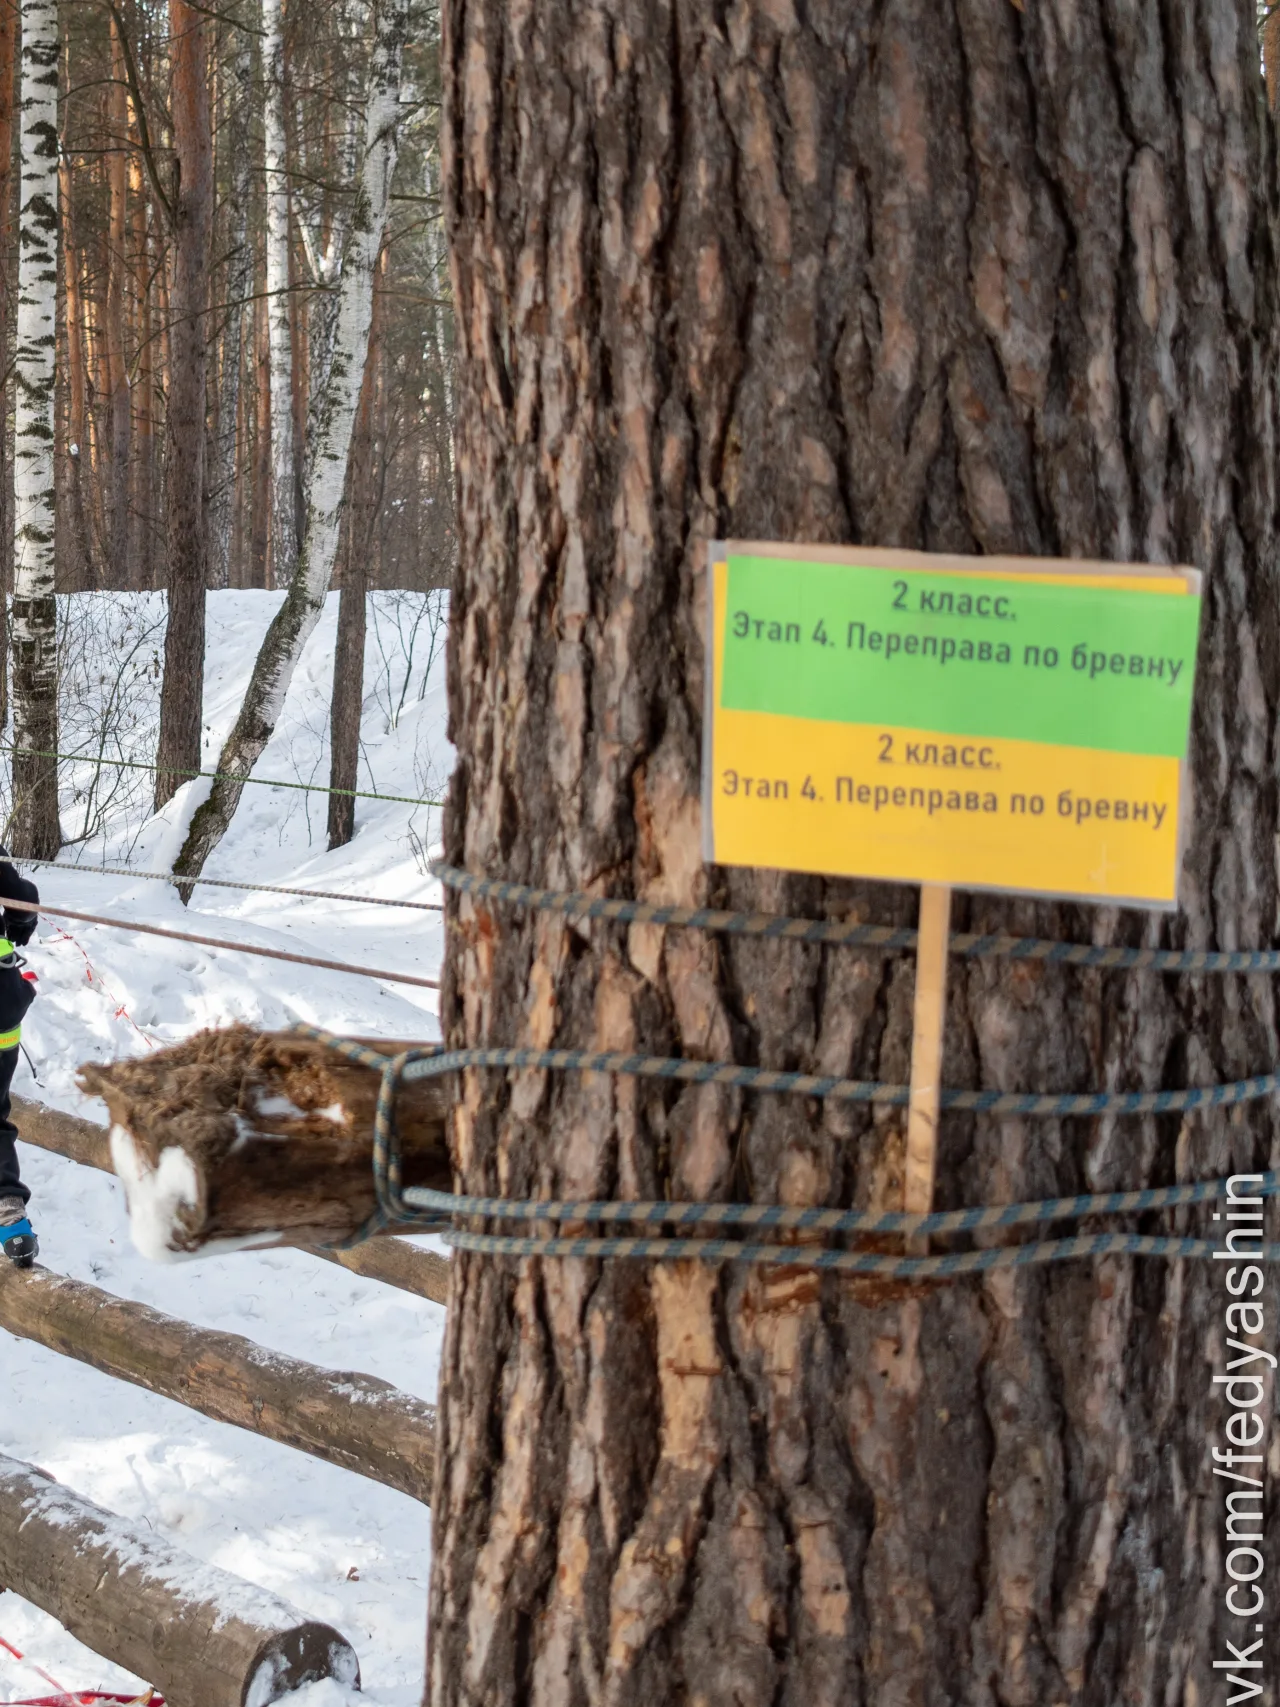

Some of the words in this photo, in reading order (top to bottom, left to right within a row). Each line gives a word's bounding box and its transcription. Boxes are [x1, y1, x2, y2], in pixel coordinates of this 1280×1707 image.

[892, 580, 908, 610] 2
[921, 589, 1017, 621] класс.
[733, 610, 800, 643] Этап
[812, 618, 835, 647] 4.
[847, 621, 1011, 665] Переправа
[1023, 645, 1059, 668] по
[1071, 642, 1184, 686] бревну
[878, 733, 894, 762] 2
[905, 742, 1002, 770] класс.
[722, 769, 789, 799] Этап
[800, 774, 824, 802] 4.
[835, 776, 998, 816] Переправа
[1010, 793, 1045, 816] по
[1057, 789, 1167, 831] бревну
